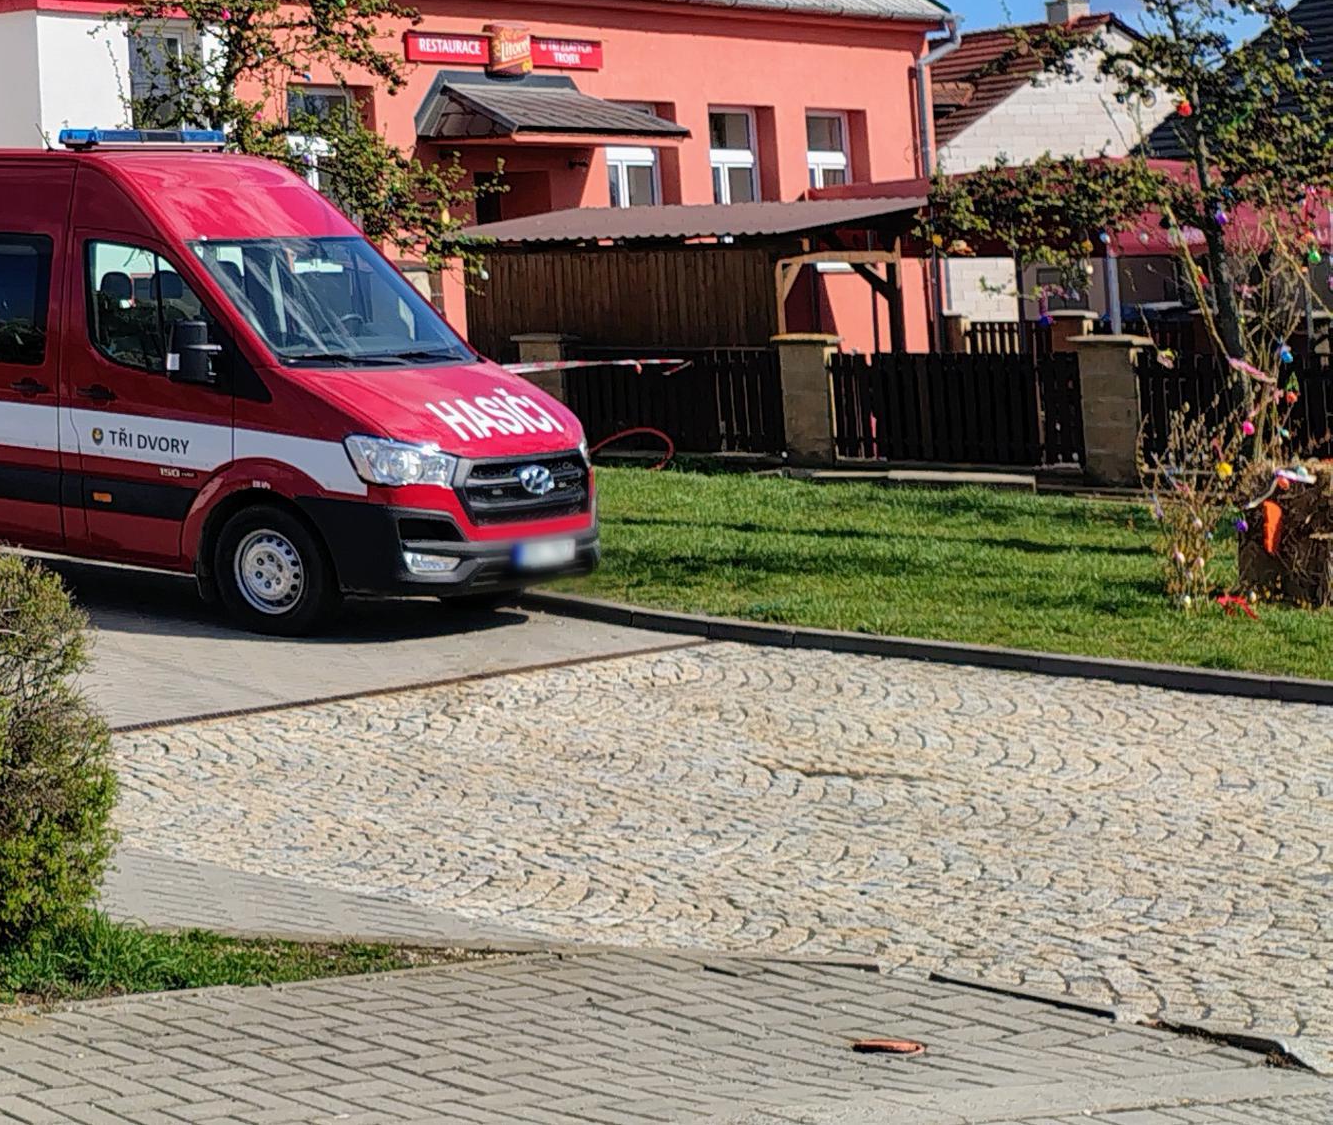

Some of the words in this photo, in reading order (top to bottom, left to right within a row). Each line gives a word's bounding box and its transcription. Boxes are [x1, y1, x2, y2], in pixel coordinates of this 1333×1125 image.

[419, 38, 481, 55] RESTAURACE
[425, 387, 564, 441] HASIČI
[109, 428, 133, 448] TŘI
[137, 434, 190, 455] DVORY
